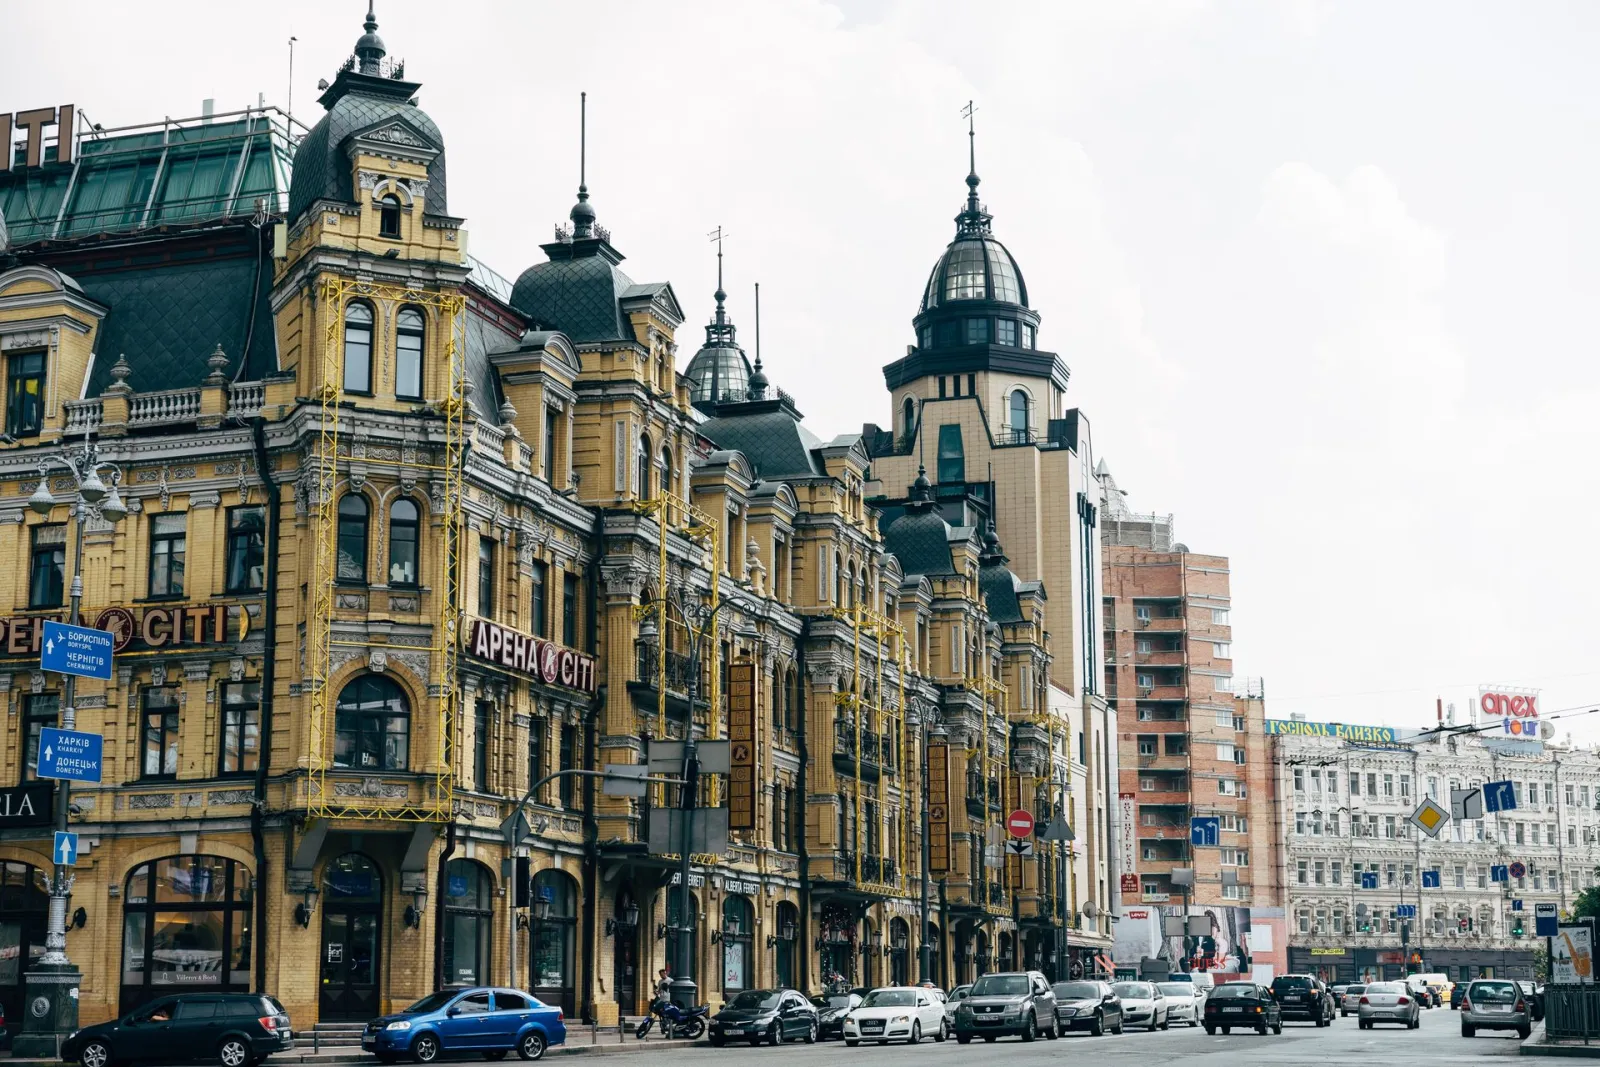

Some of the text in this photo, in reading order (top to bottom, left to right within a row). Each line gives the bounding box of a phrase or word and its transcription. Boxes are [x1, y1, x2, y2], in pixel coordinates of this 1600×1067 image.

[142, 605, 224, 648] СІТІ
[67, 641, 93, 651] BORYSPIL
[68, 631, 111, 647] БОРИСПІЛЬ
[66, 652, 104, 666] ЧЕРНІГІВ
[475, 621, 594, 691] АРЕНА СІТІ
[66, 661, 97, 672] CHERNIHIV
[735, 667, 747, 741] АРЕНА
[1481, 693, 1538, 718] anex
[1270, 720, 1392, 742] ГОСПОДЬ БЛИЗКО
[1503, 717, 1538, 736] tour
[57, 745, 83, 754] KHARKIV
[58, 735, 90, 748] ХАРКІВ
[56, 757, 98, 770] ДОНЕЦЬК
[56, 766, 83, 775] DONETSK
[0, 792, 36, 817] IA
[725, 879, 760, 896] ALBERTA FERRETTI
[1188, 957, 1226, 970] GUESS
